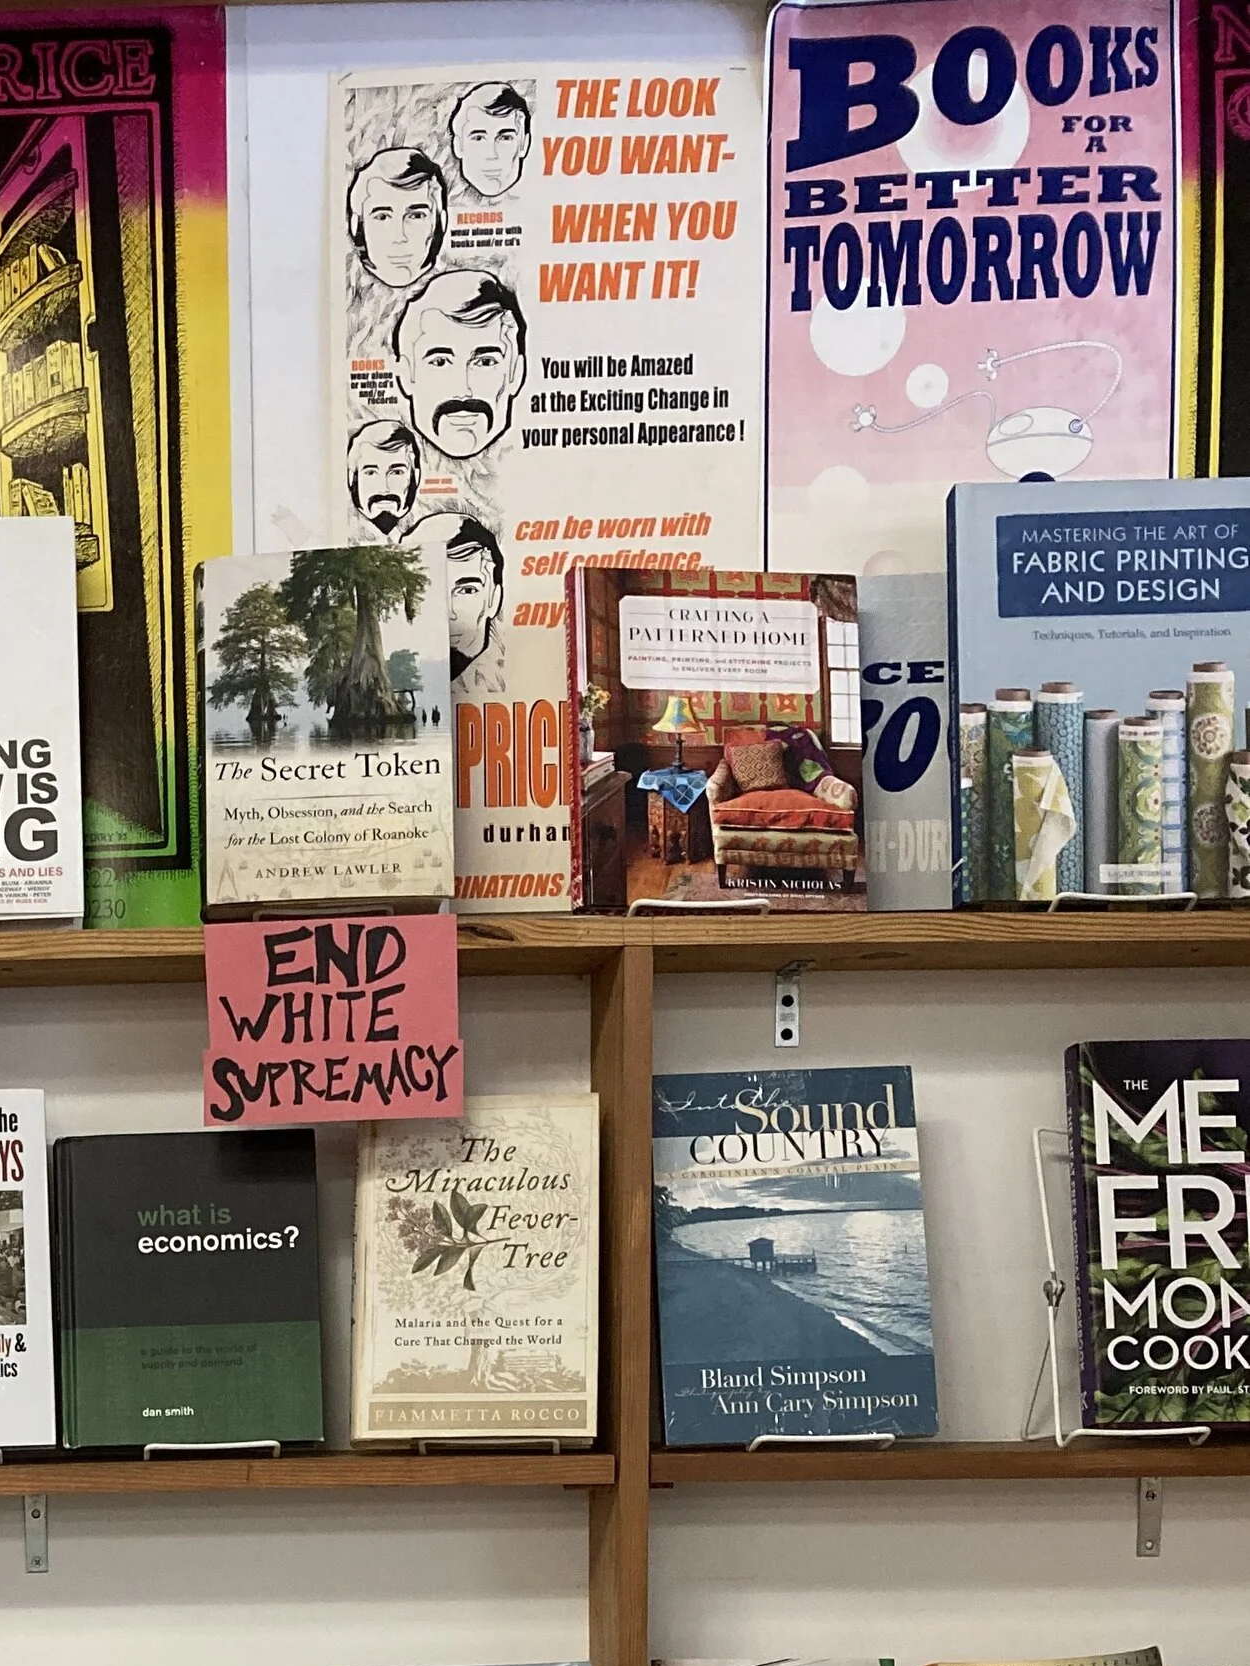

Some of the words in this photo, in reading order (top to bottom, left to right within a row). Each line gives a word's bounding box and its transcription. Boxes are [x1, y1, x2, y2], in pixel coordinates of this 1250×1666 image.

[1013, 548, 1109, 575] FABRIC
[1118, 545, 1249, 572] PRINTING
[1042, 581, 1104, 604] AND
[1112, 578, 1220, 602] DESIGN
[669, 608, 751, 624] CRAFTING
[756, 611, 770, 624] A
[629, 628, 747, 646] PATTERNED
[753, 629, 811, 646] HOME
[216, 761, 253, 782] The
[261, 755, 346, 781] Secret
[356, 751, 441, 779] Token
[18, 772, 58, 802] IS
[8, 867, 33, 878] AND
[37, 866, 62, 877] LIES
[265, 923, 406, 988] END
[220, 983, 406, 1044] WHITE
[210, 1045, 459, 1122] SUPREMACY
[1123, 1079, 1149, 1091] THE
[461, 1138, 517, 1163] The
[690, 1127, 888, 1166] COUNTRY
[385, 1169, 571, 1195] Miraculous
[487, 1206, 579, 1230] Fever-
[138, 1227, 299, 1254] economics?
[500, 1243, 568, 1269] Tree
[701, 1367, 764, 1390] Bland
[771, 1367, 867, 1390] Simpson
[143, 1408, 161, 1417] dan
[164, 1406, 194, 1417] smith
